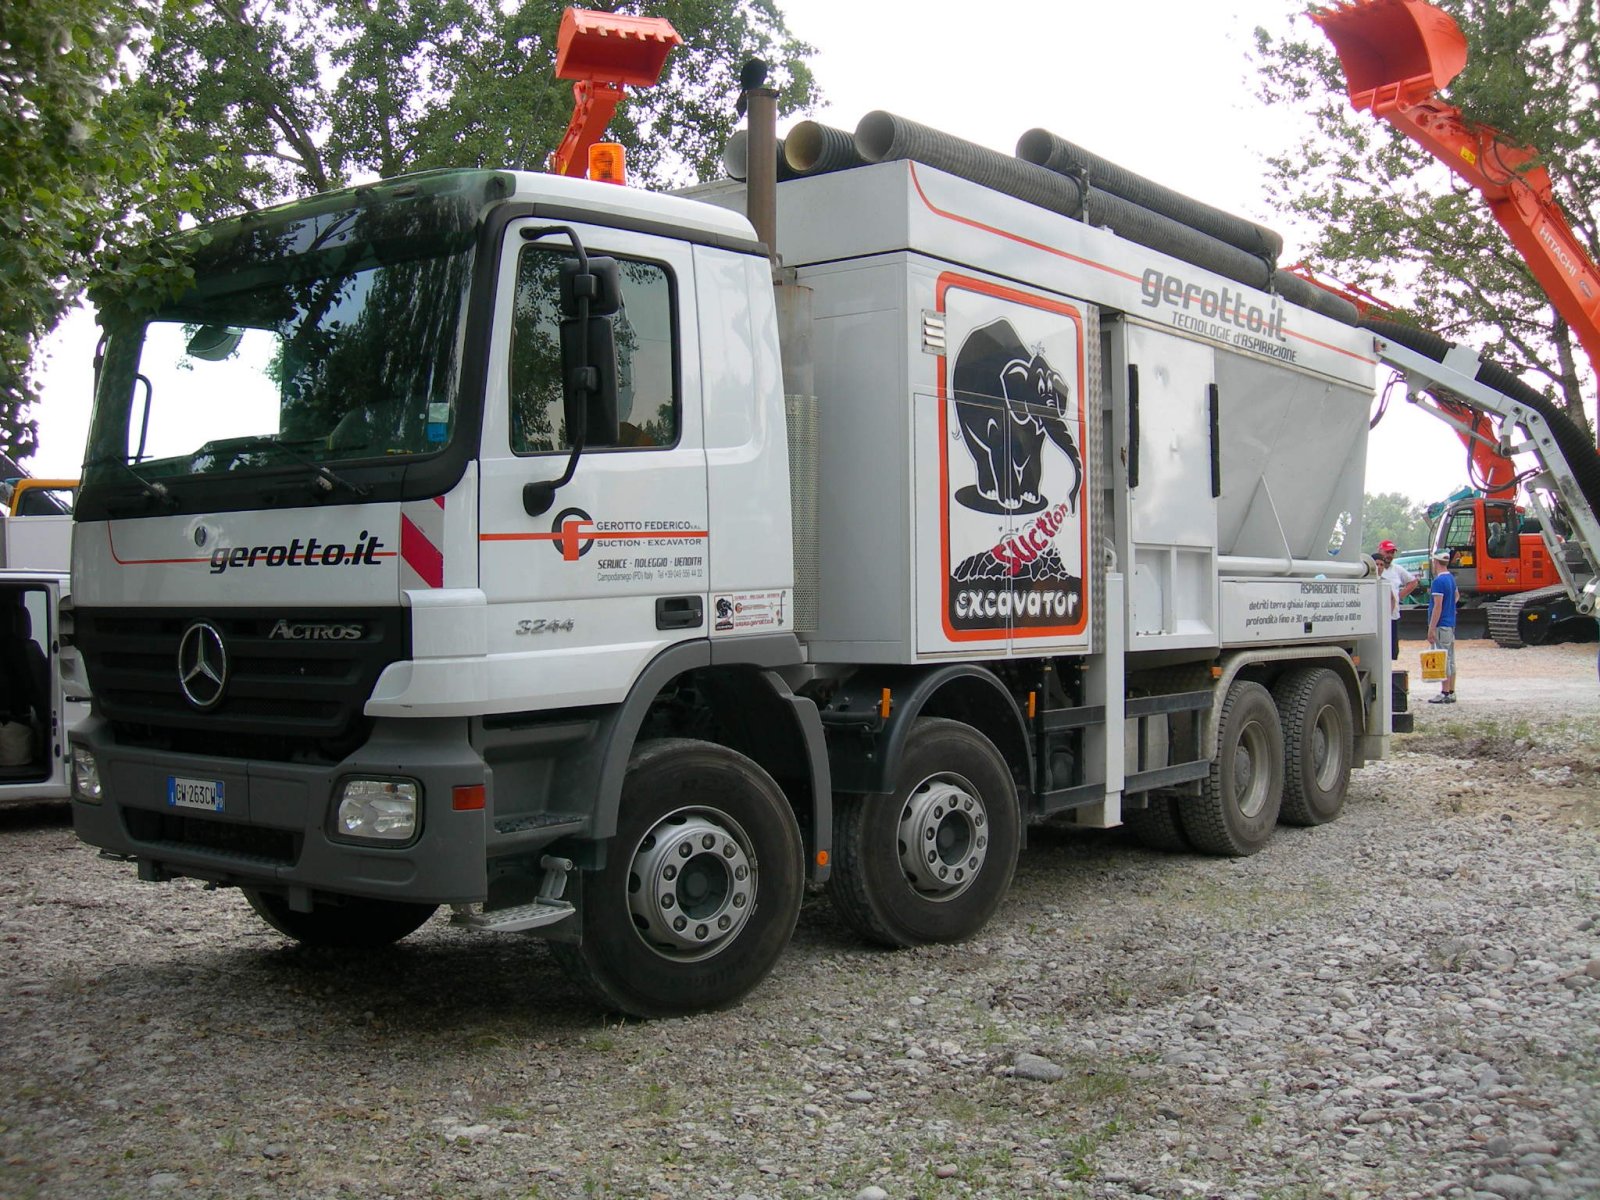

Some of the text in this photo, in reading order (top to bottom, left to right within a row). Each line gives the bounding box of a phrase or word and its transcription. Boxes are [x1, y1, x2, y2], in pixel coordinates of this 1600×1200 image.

[1540, 226, 1577, 278] HITACHI
[1141, 267, 1287, 342] gerotto.it
[1172, 311, 1231, 342] TECNOLOGIE
[596, 521, 643, 531] GEROTTO
[644, 521, 691, 530] FEDERICO
[597, 540, 641, 548] SUCTION
[648, 538, 702, 547] EXCAVATOR
[210, 530, 384, 574] gerotto.it
[597, 559, 628, 570] SERVICE
[634, 557, 668, 569] NOLEGGIO
[674, 556, 702, 567] VENDITA
[1300, 584, 1361, 595] ASPIRAZIONE TOTALE
[1248, 598, 1362, 611] detriti terra ghiaia fango calcinacci sabbia
[1278, 613, 1290, 624] fino
[1334, 612, 1345, 622] fino
[515, 618, 575, 636] 3244
